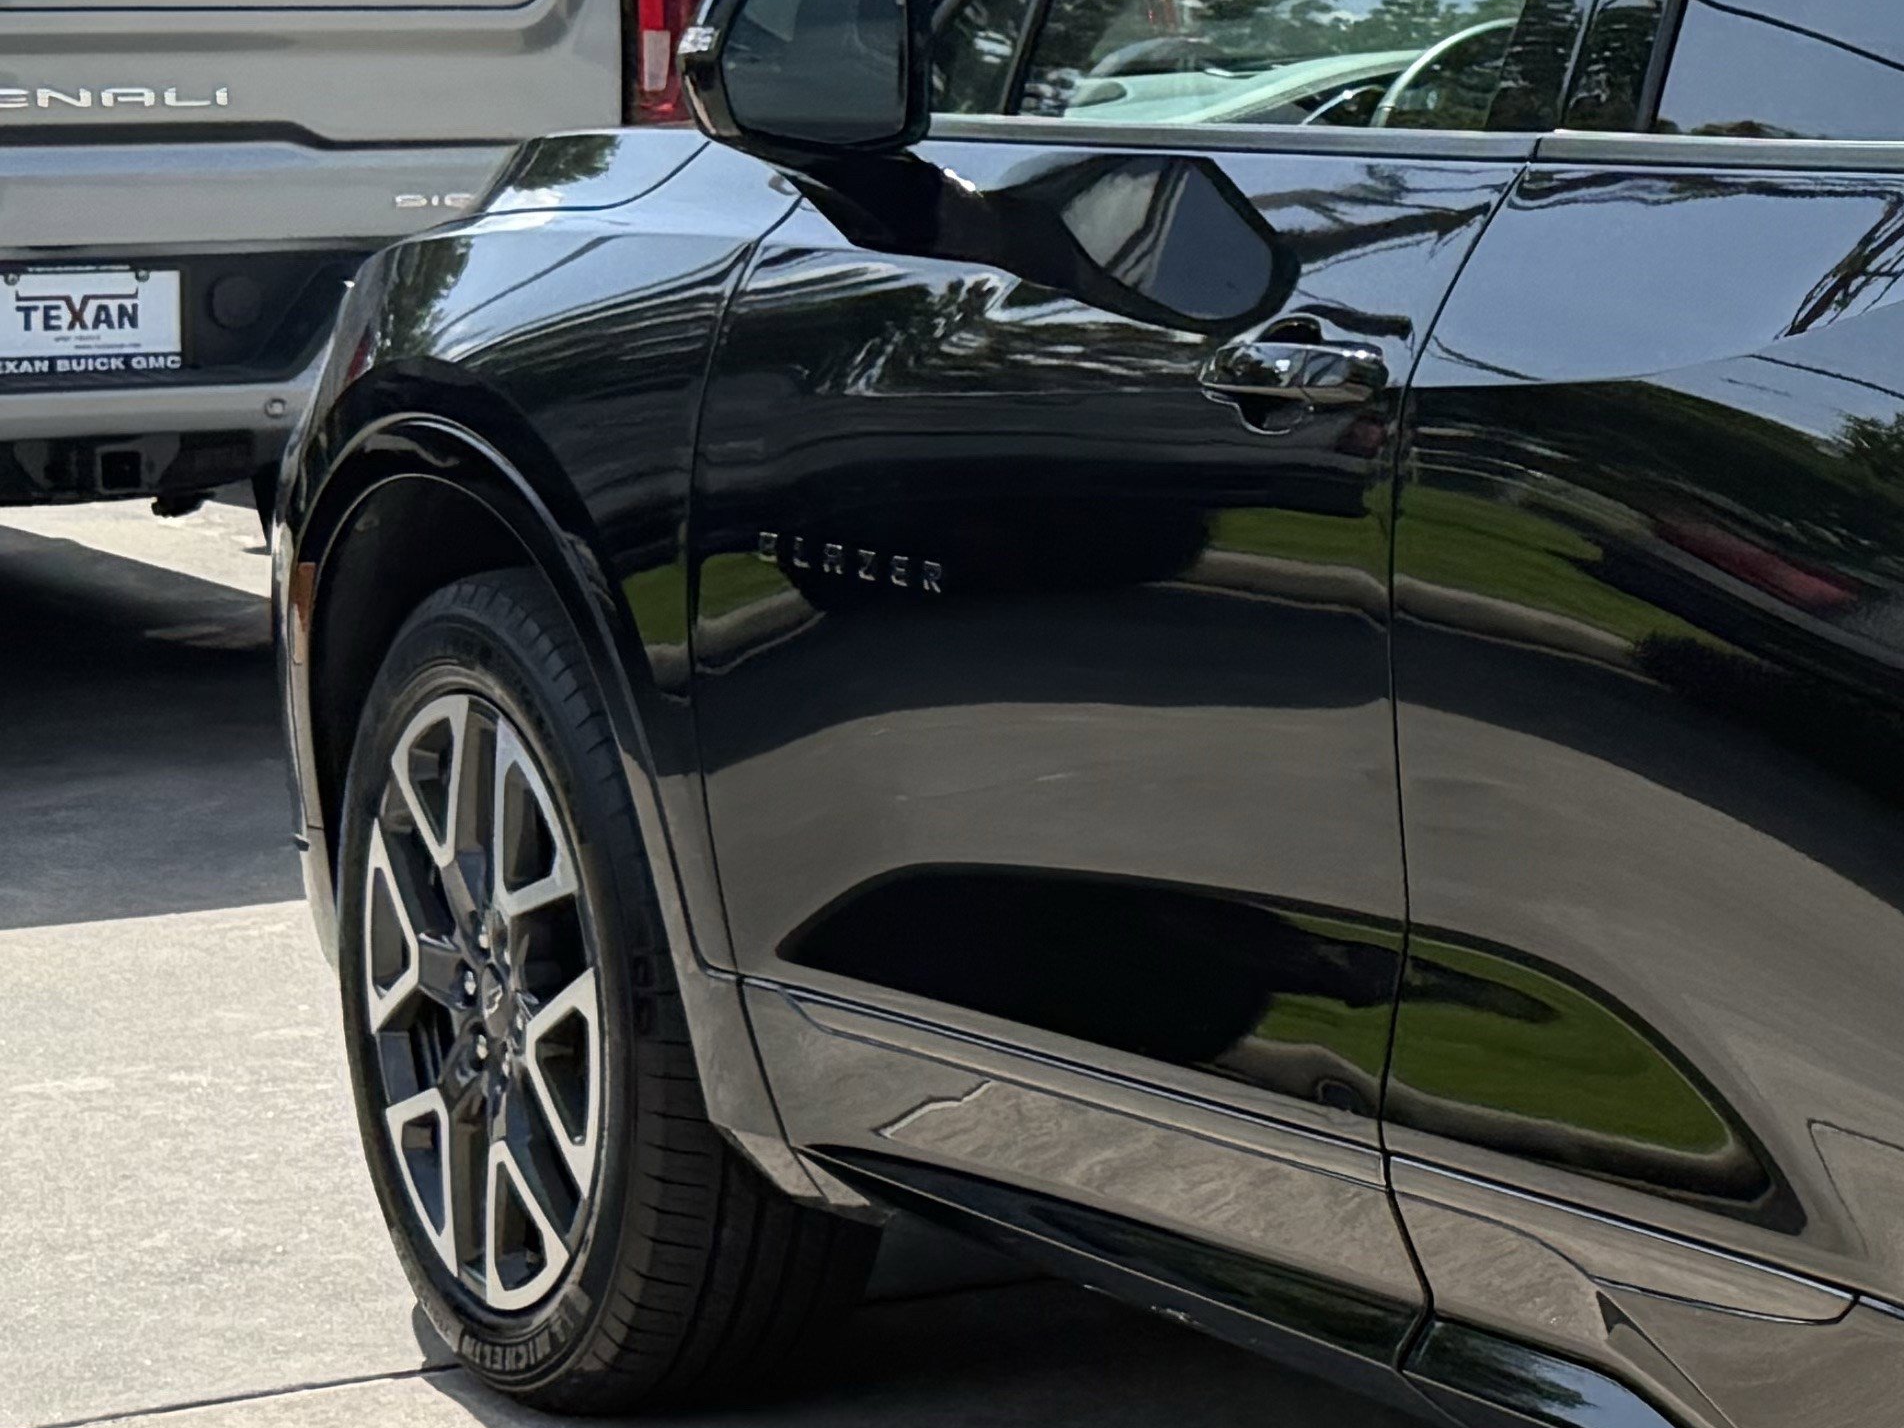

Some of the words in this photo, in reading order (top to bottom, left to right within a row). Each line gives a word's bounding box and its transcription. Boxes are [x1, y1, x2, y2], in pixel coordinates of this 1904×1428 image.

[15, 293, 139, 332] TEXAN
[55, 356, 126, 373] BUICK
[130, 355, 182, 370] GMC
[758, 530, 943, 594] BLAZER
